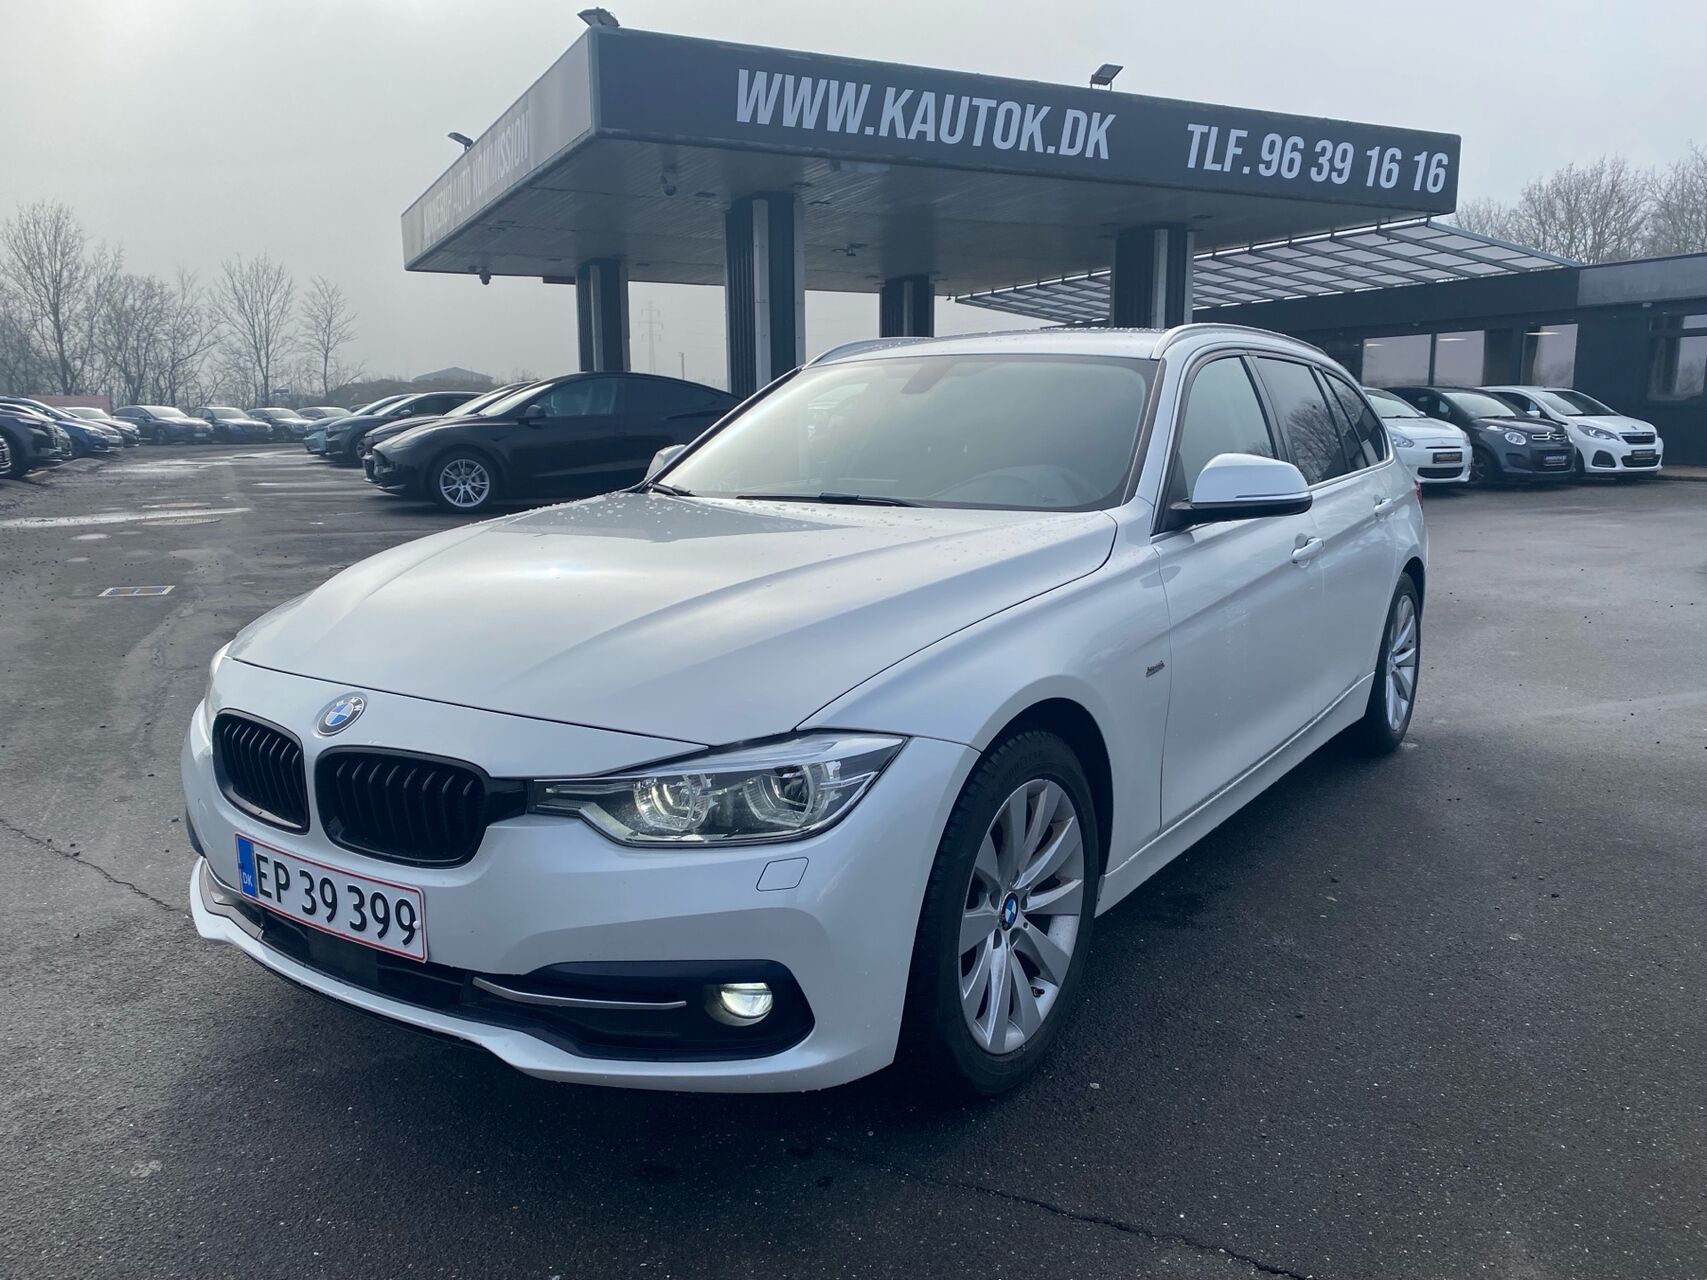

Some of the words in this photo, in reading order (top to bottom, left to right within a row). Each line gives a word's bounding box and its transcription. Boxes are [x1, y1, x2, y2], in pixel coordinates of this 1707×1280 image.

[736, 69, 1116, 160] WWW.KAUTOK.DK
[1187, 123, 1250, 174] TLF.
[1258, 133, 1305, 179] 96
[1310, 139, 1354, 185] 39
[1366, 146, 1402, 189] 16
[1413, 151, 1449, 194] 16
[242, 871, 254, 887] DK
[256, 853, 291, 903] EP
[299, 869, 338, 923] 39
[347, 884, 417, 946] 399
